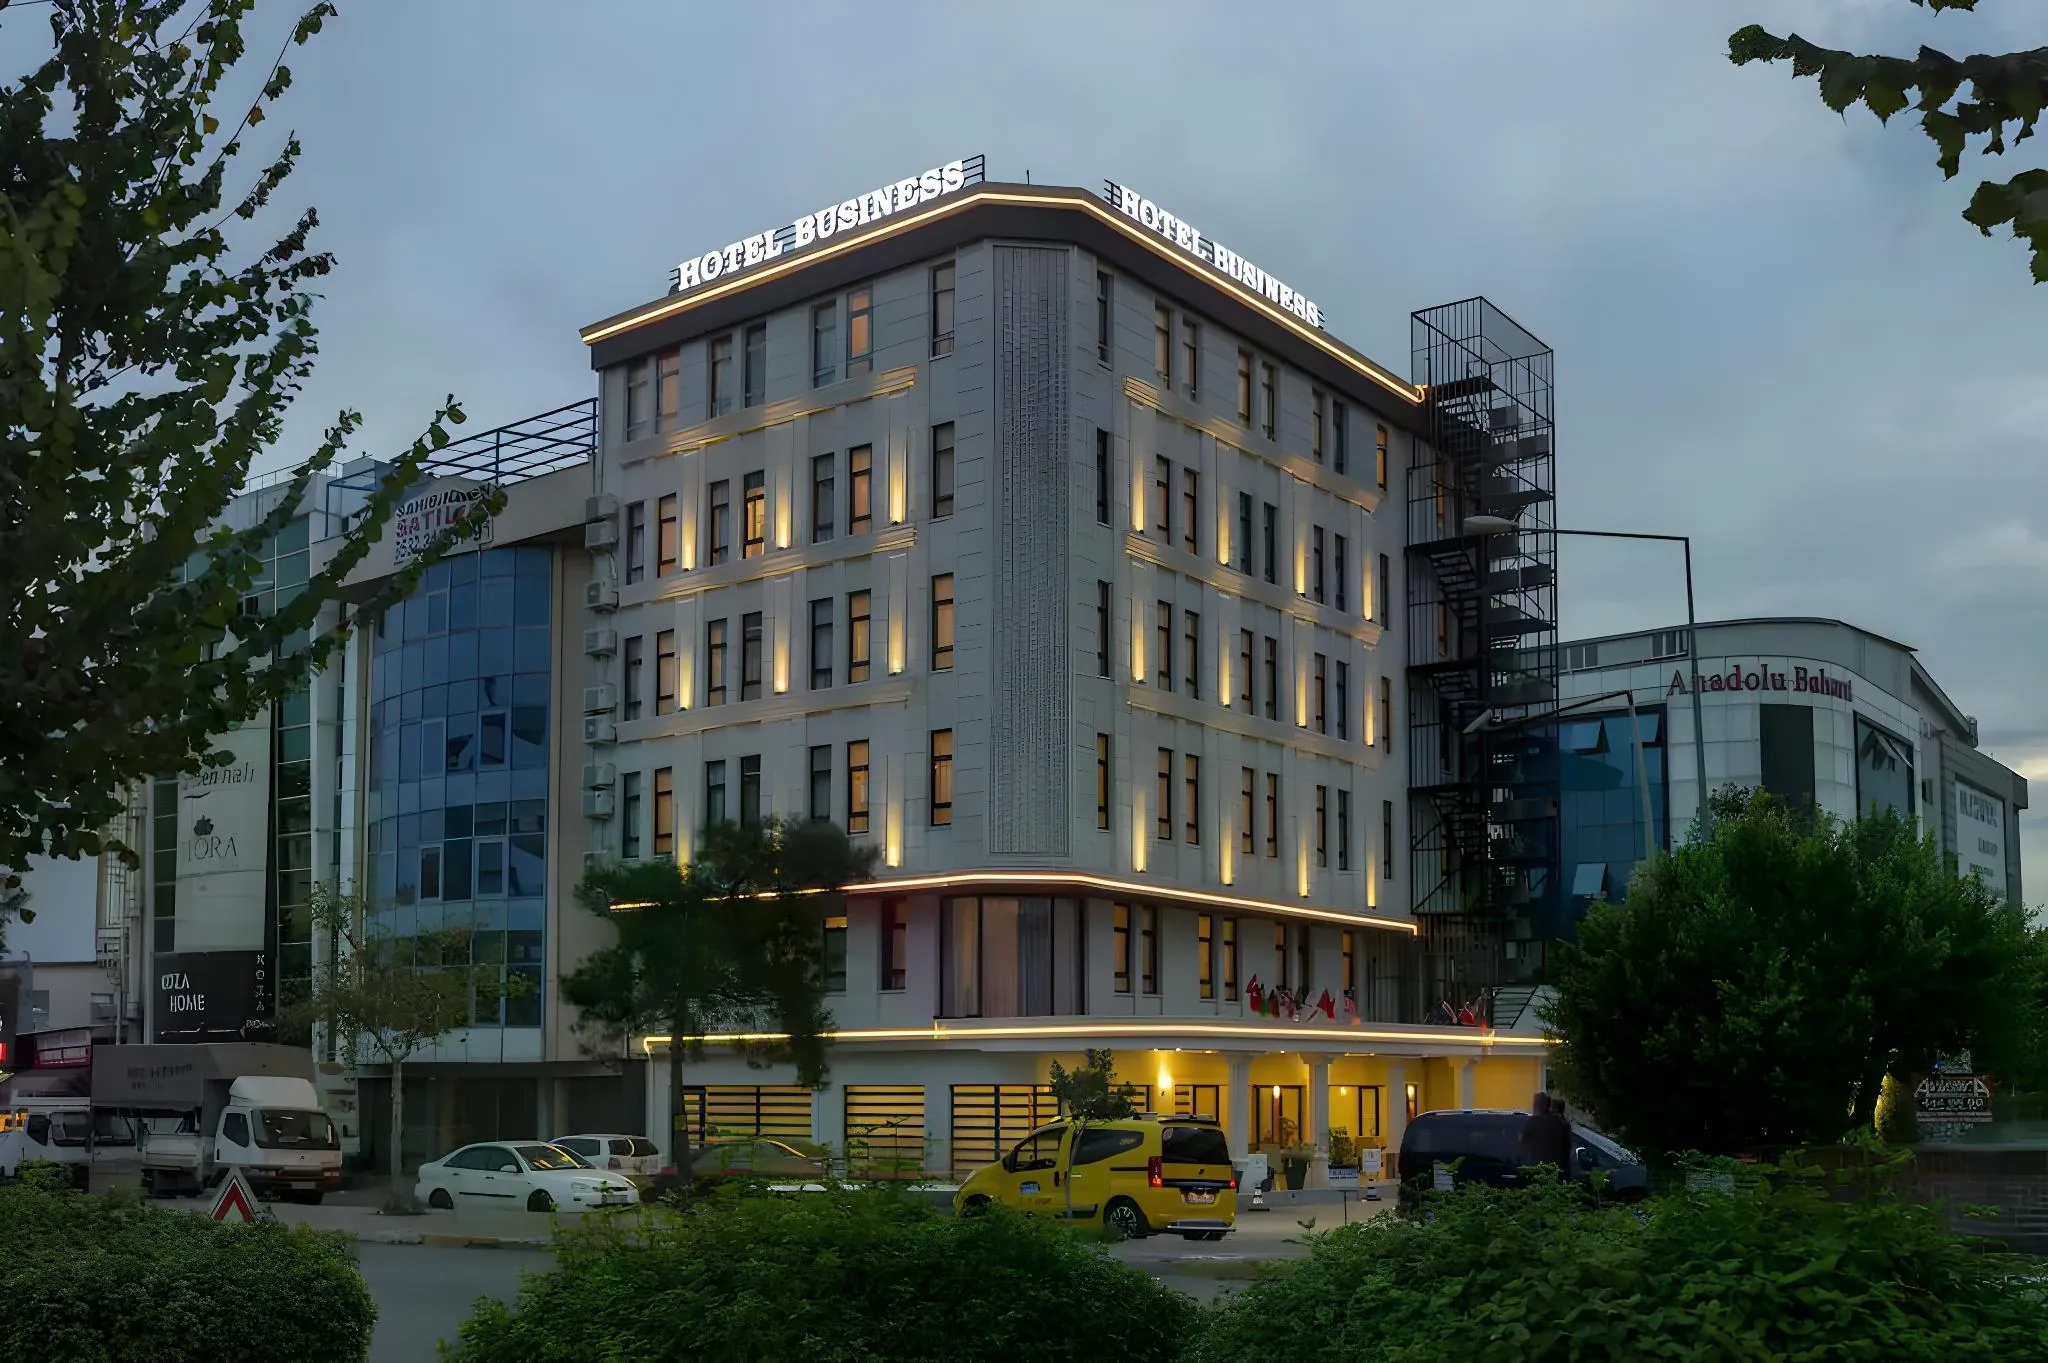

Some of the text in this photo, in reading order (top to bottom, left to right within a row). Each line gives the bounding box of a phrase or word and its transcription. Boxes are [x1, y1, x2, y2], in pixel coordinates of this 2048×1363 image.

[678, 160, 966, 291] HOTEL BUSINESS
[1119, 185, 1319, 328] HOTEL BUSINESS
[170, 993, 205, 1013] HOME
